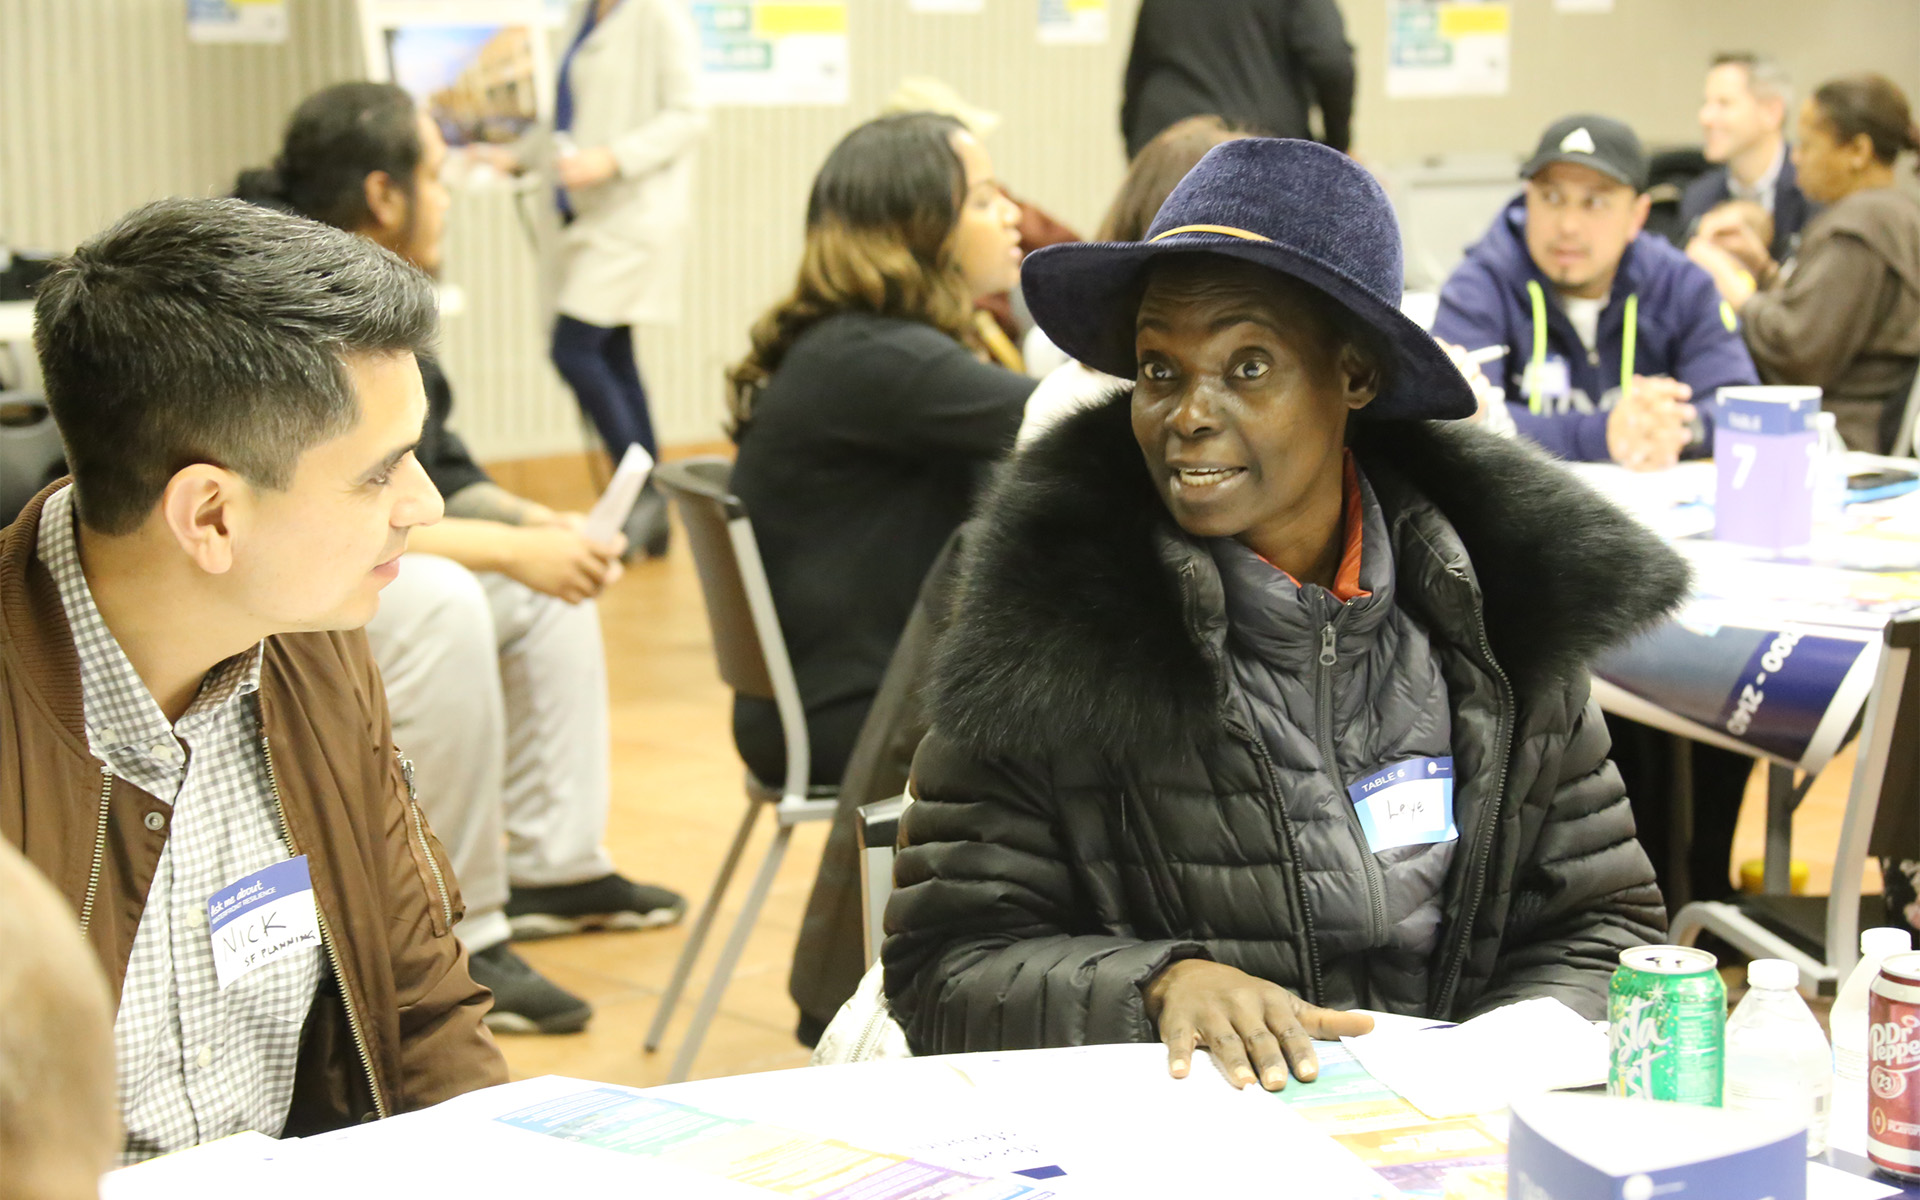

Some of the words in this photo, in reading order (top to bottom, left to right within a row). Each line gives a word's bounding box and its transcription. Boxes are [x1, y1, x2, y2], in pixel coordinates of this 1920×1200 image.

[1731, 443, 1757, 490] 7
[1362, 772, 1396, 792] TABLE
[1397, 769, 1406, 778] 6
[224, 896, 236, 907] me
[237, 880, 264, 900] about
[223, 911, 287, 962] NICK
[245, 954, 256, 967] SF
[261, 930, 316, 958] PLANNING
[1869, 1022, 1920, 1066] Peppe
[1885, 1022, 1913, 1044] Dr
[1877, 1073, 1892, 1091] 23
